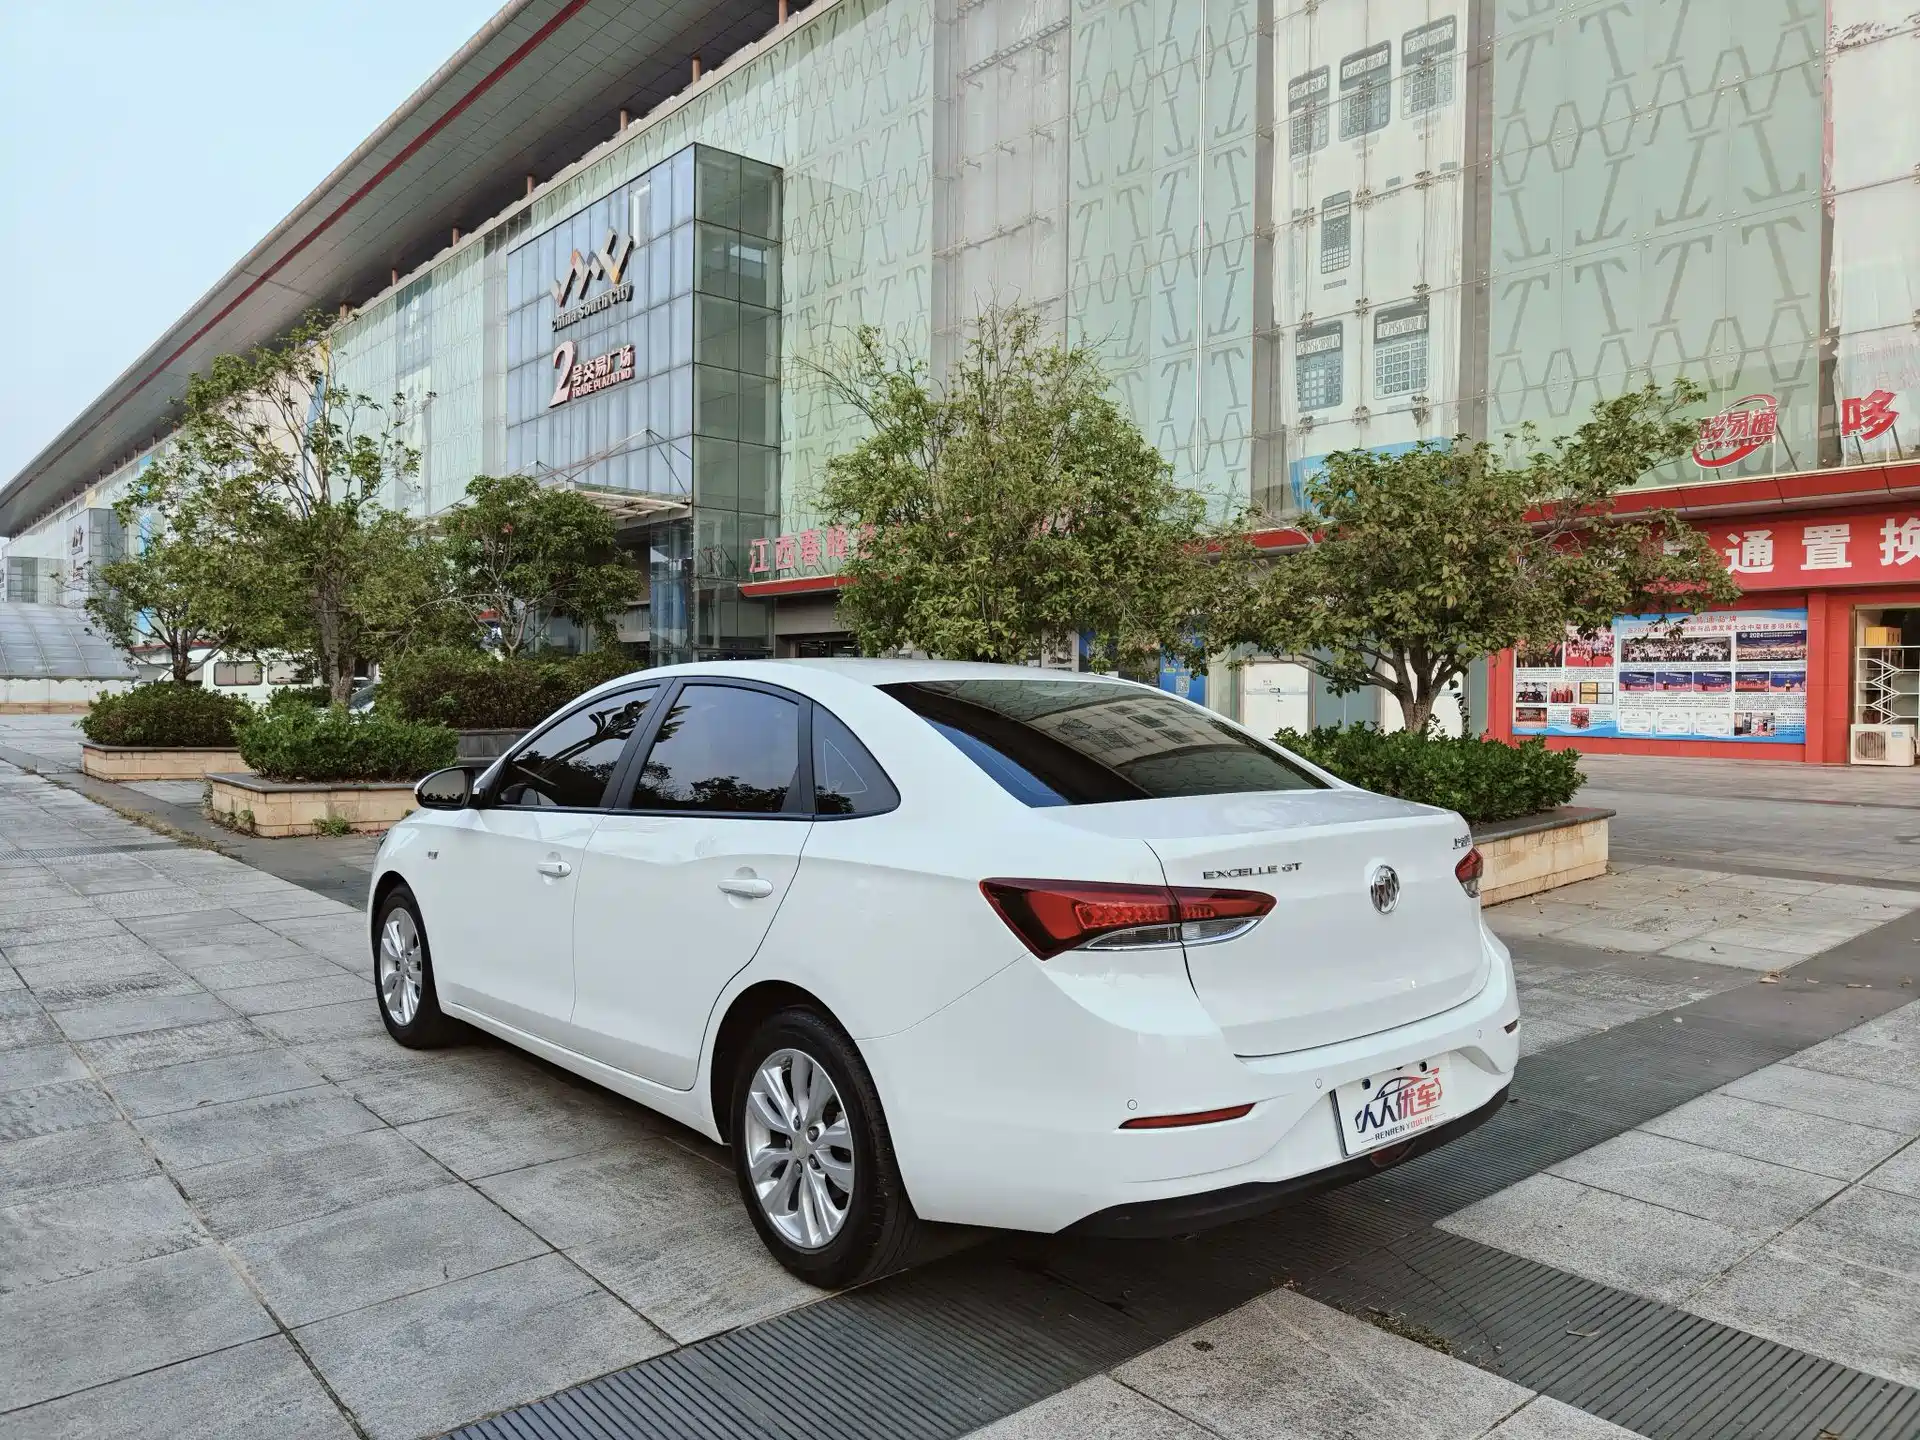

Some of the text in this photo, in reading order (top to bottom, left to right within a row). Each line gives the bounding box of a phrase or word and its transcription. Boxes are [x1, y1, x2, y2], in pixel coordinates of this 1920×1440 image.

[552, 283, 632, 331] China South City
[572, 367, 633, 398] TRADE PLAZA TWO
[1203, 862, 1303, 880] EXCELLE GT
[1375, 1125, 1405, 1141] RENREN
